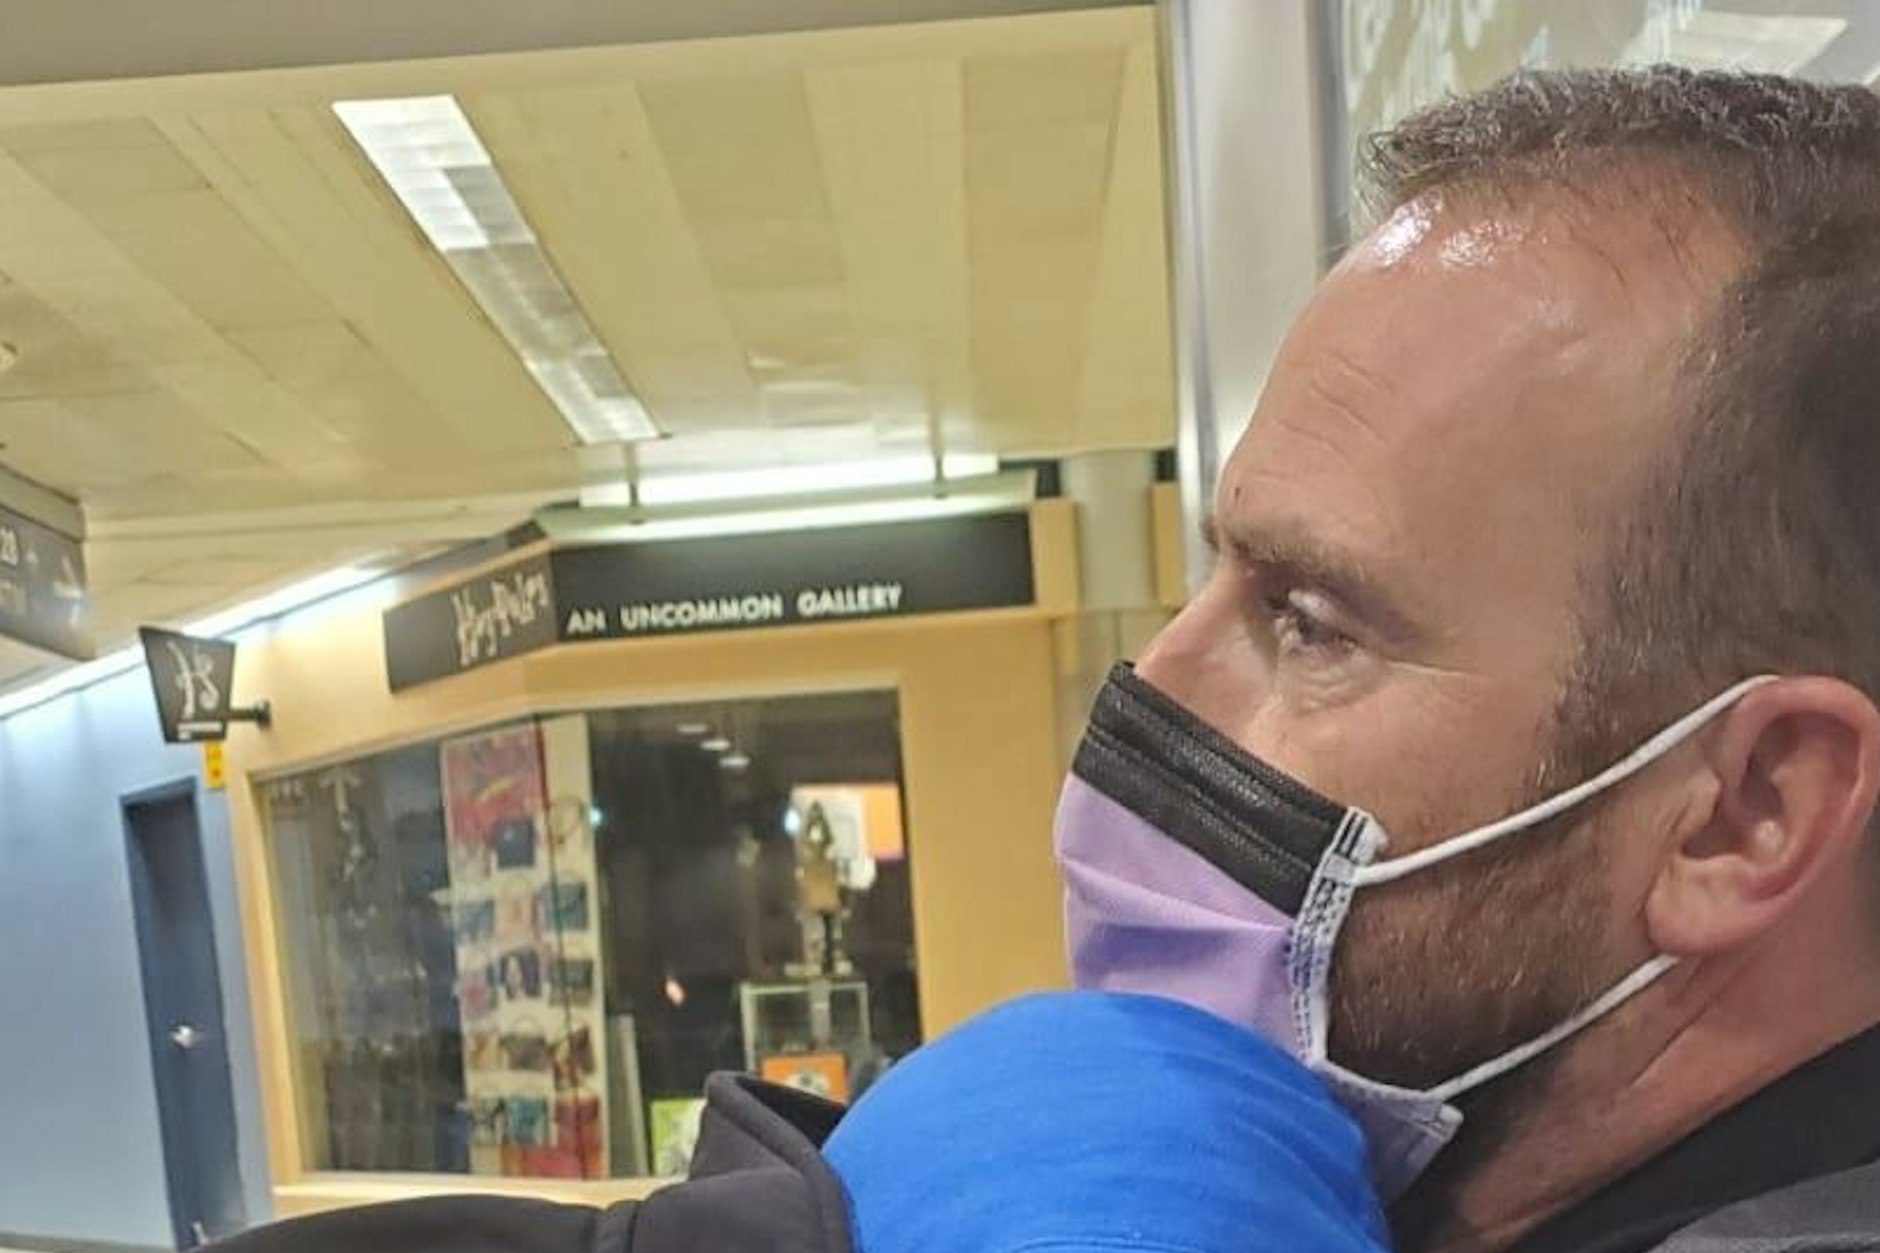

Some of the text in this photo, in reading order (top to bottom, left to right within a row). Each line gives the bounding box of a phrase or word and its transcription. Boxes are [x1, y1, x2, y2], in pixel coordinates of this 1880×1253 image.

[566, 582, 903, 634] AN UNCOMMON GALLERY
